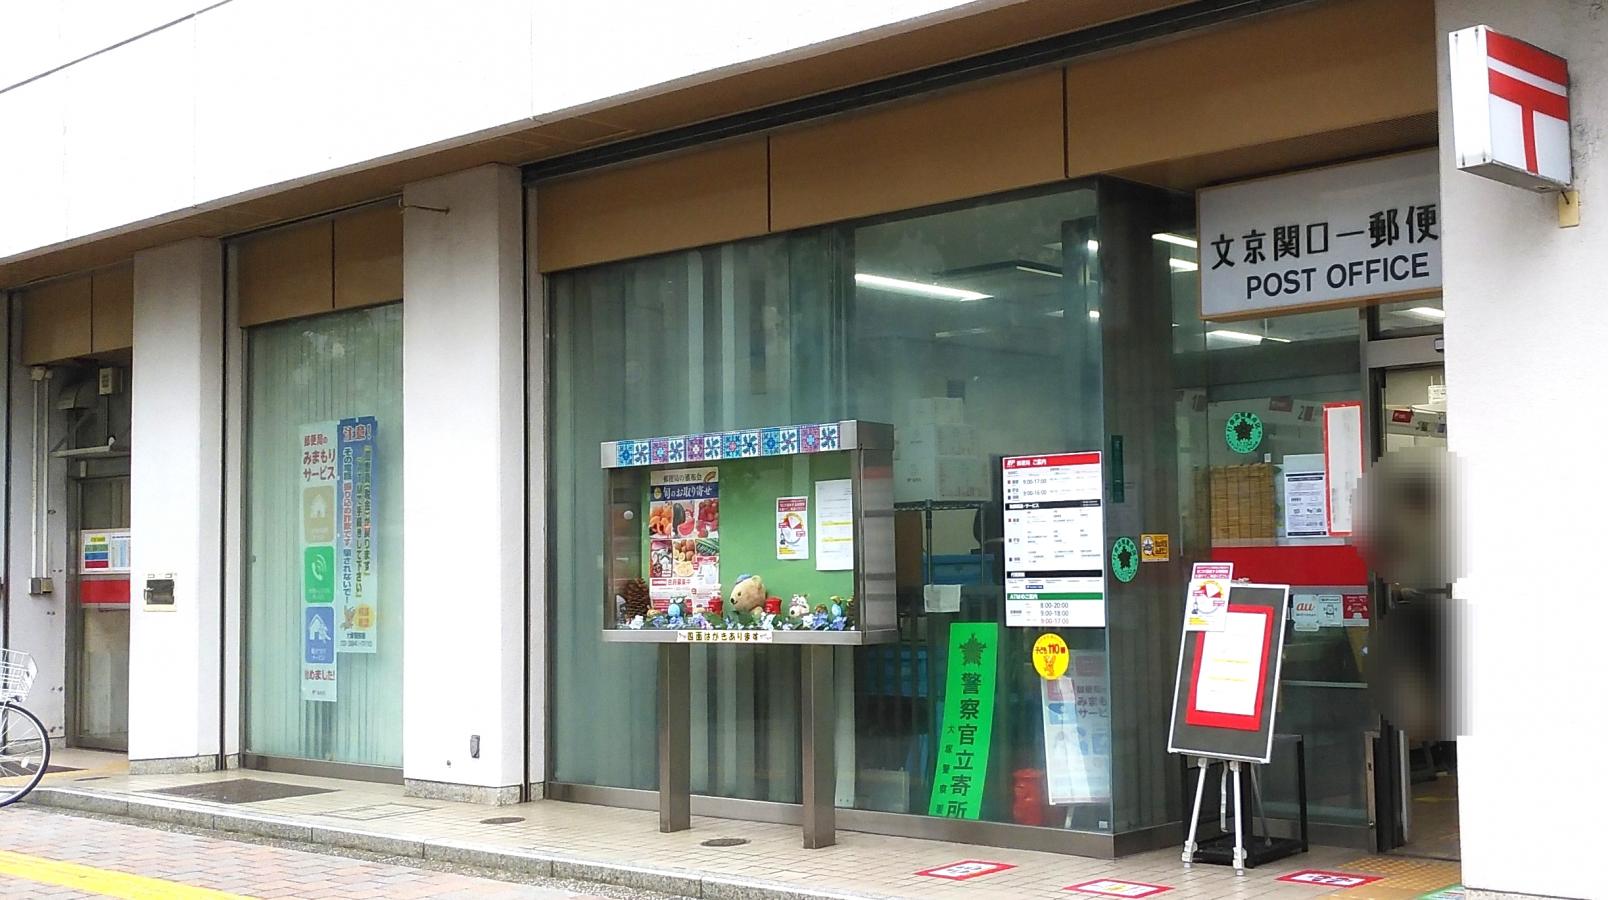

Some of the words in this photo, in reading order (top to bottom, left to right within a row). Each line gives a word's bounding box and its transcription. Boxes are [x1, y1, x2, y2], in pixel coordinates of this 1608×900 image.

[1210, 204, 1438, 270] 文京関口一郵便
[1246, 268, 1317, 299] POST
[1326, 252, 1430, 289] OFFICE
[303, 448, 336, 465] みまもり
[303, 465, 336, 482] サービス
[663, 485, 713, 499] 旬のお取り寄せ
[1296, 602, 1313, 611] au
[946, 672, 983, 818] 警察官立寄所
